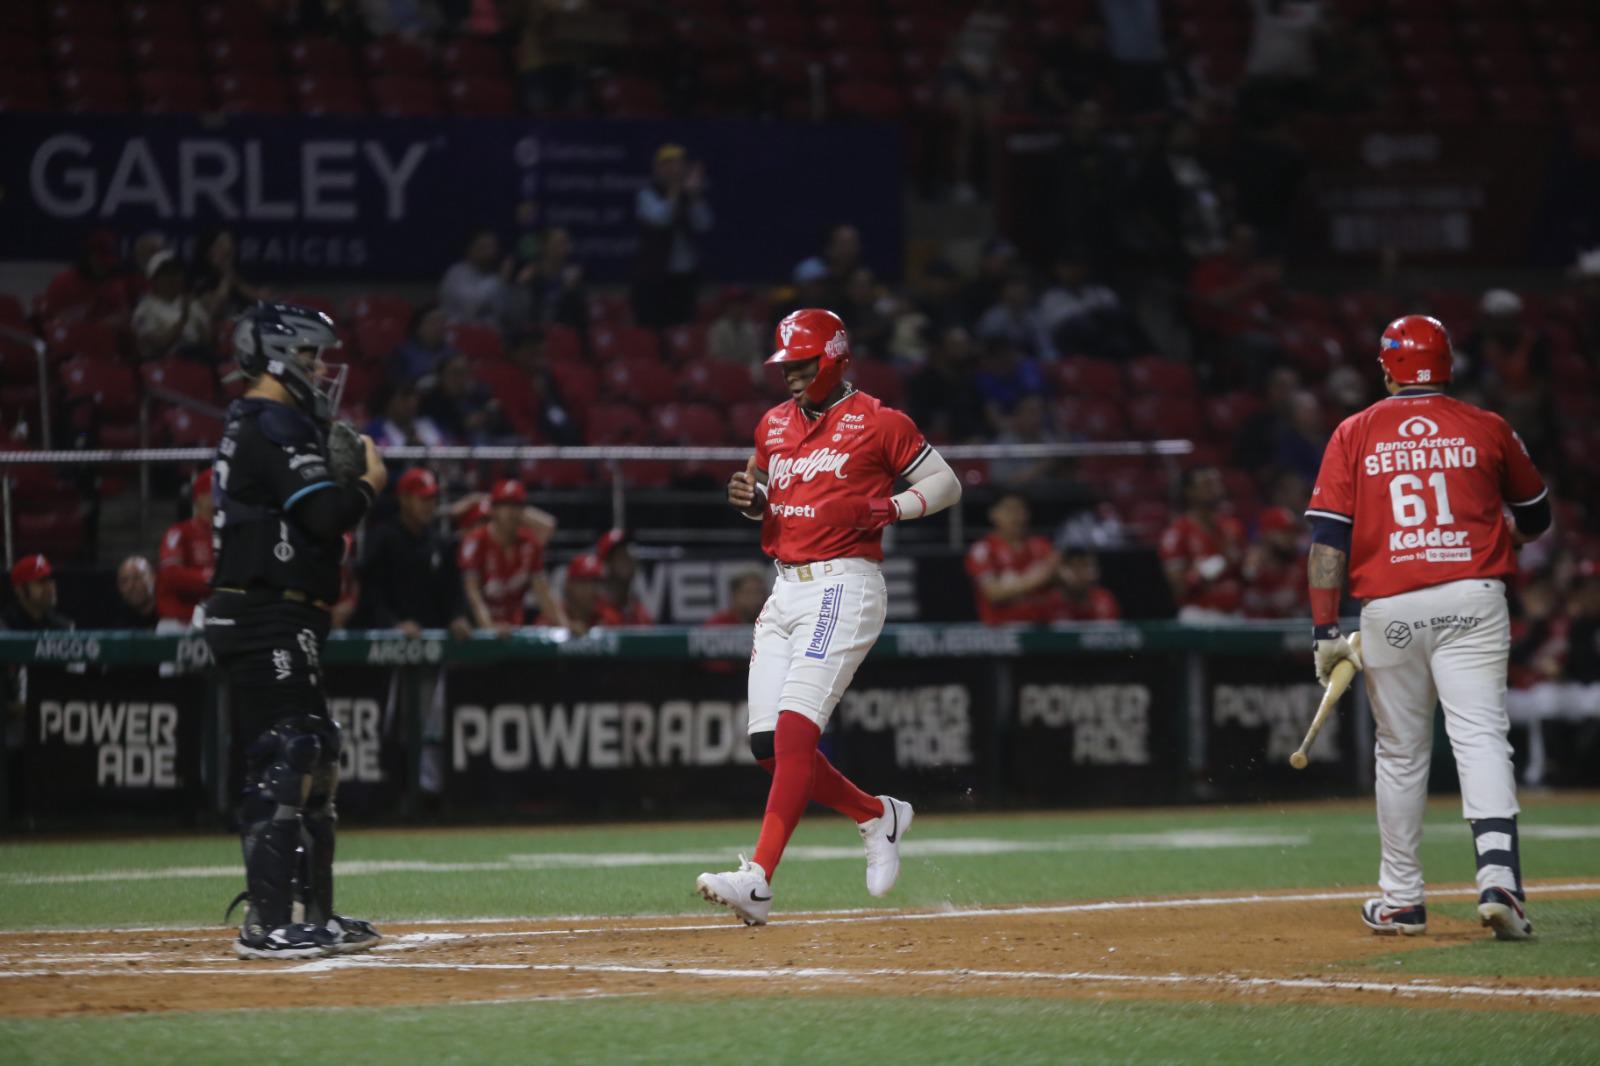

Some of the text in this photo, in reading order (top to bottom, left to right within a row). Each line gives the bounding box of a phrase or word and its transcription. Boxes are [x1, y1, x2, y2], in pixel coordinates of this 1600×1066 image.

[29, 133, 429, 220] GARLEY
[1365, 446, 1477, 476] SERRANO
[1376, 437, 1465, 453] Banco Azteca
[1389, 472, 1455, 528] 61
[1389, 528, 1469, 551] Kelder
[1413, 619, 1427, 630] EL
[39, 699, 179, 745] POWER
[97, 742, 177, 788] ADE
